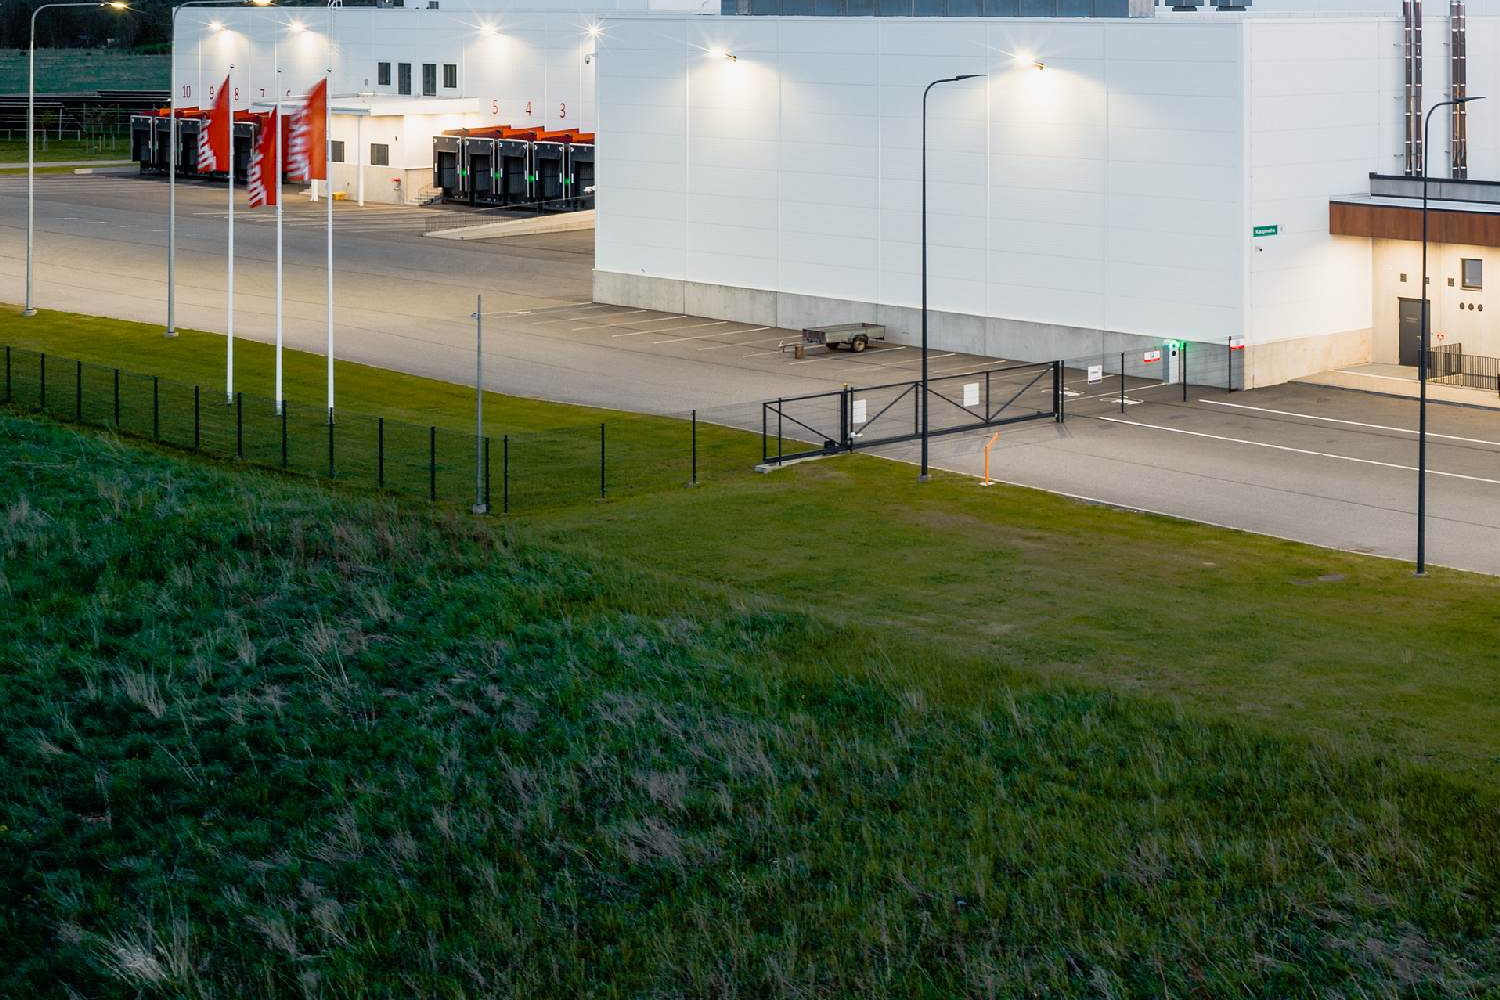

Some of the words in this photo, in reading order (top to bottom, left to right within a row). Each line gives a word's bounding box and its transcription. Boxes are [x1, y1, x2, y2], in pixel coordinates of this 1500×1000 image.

[182, 85, 192, 98] 10
[209, 86, 215, 100] 9
[234, 87, 240, 101] 8
[491, 99, 499, 115] 5
[525, 101, 532, 117] 4
[559, 102, 566, 119] 3
